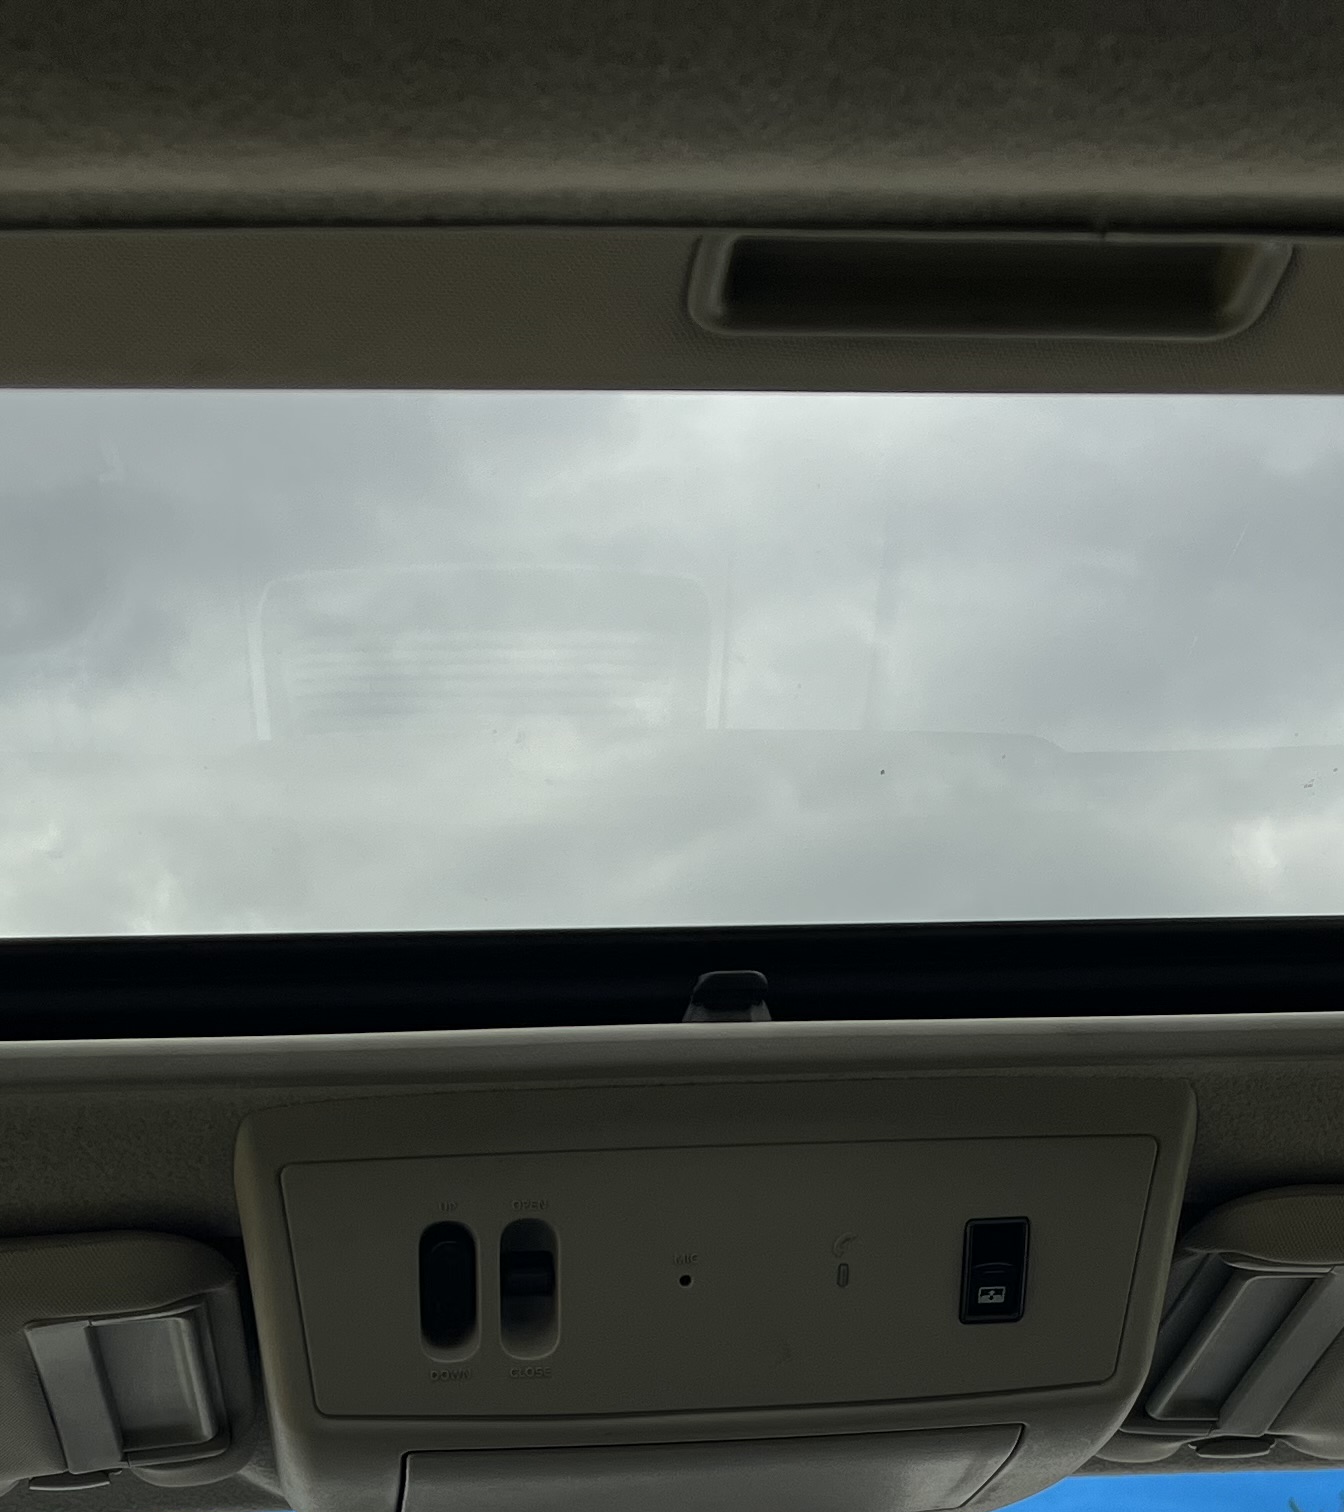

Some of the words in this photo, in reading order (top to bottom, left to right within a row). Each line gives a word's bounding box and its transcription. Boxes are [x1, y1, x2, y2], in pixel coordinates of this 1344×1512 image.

[512, 1200, 548, 1211] OPEN
[429, 1369, 472, 1381] DOWN
[510, 1367, 552, 1380] CLOSE
